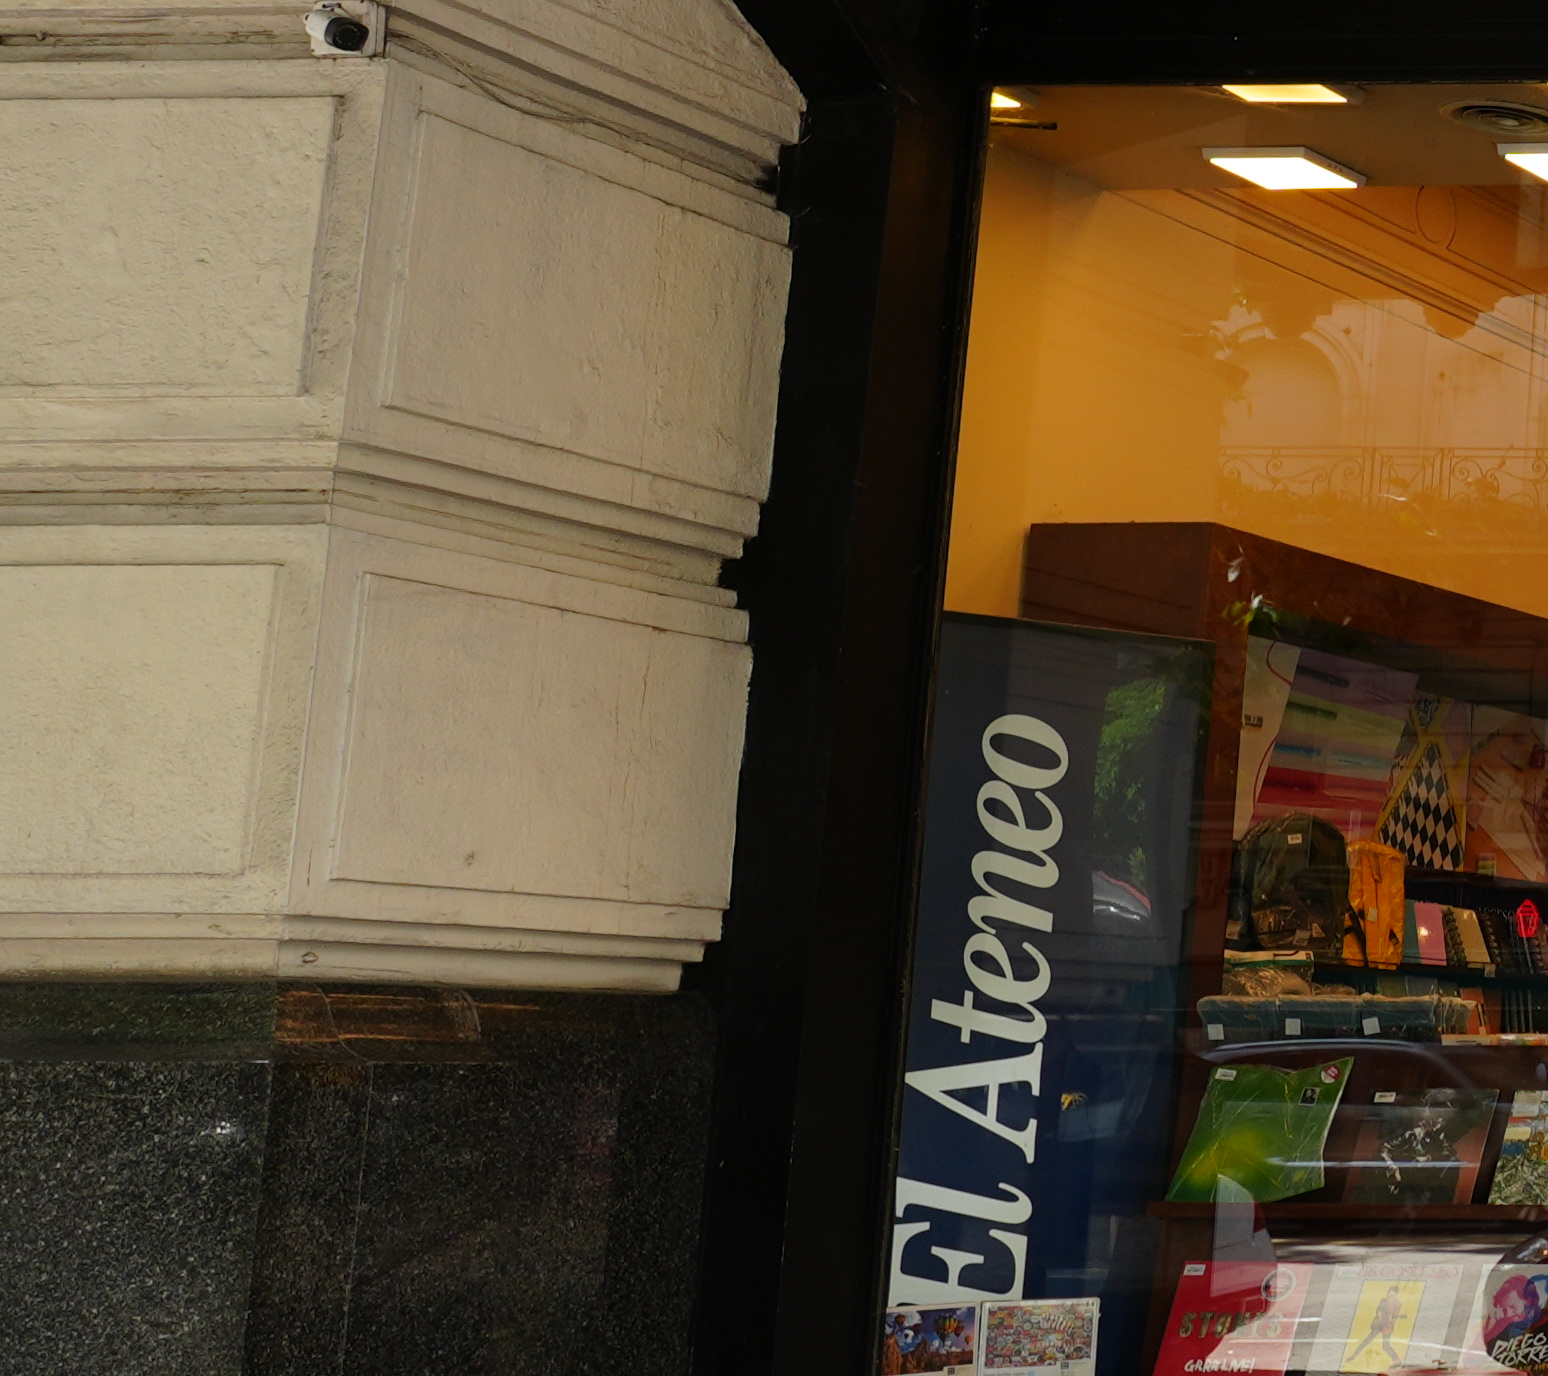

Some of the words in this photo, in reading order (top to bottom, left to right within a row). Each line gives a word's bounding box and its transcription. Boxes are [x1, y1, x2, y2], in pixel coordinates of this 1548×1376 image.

[904, 713, 1070, 1165] Ateneo
[889, 1176, 1034, 1308] El
[1491, 1331, 1548, 1359] DIEGO
